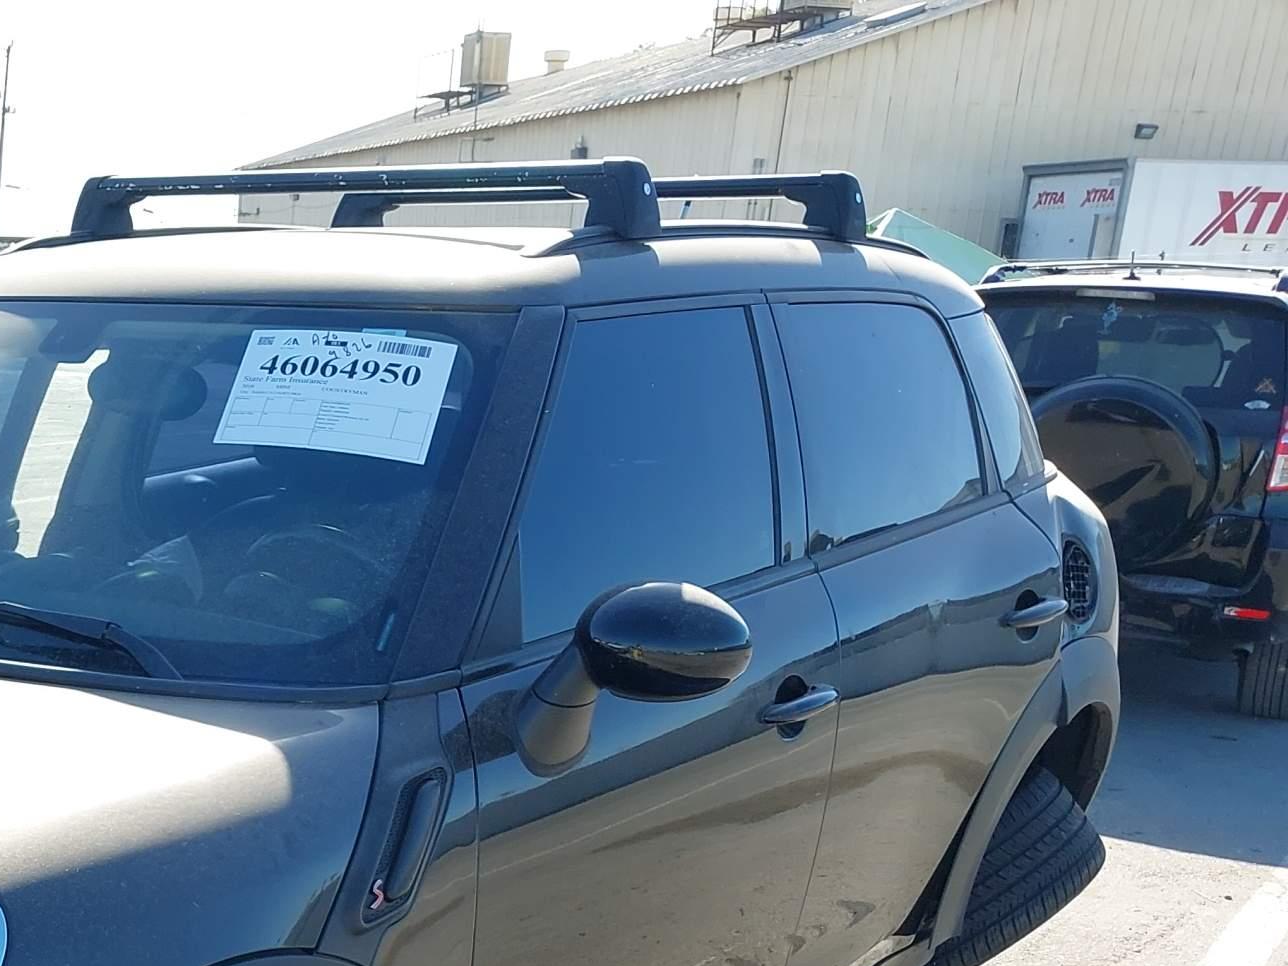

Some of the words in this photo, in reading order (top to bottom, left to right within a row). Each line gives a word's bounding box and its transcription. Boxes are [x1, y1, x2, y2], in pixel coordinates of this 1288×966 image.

[1032, 190, 1065, 209] XTRA
[1080, 187, 1115, 207] XTRA
[259, 354, 421, 386] 46064950
[265, 375, 287, 383] Farm
[289, 376, 329, 385] Insurance
